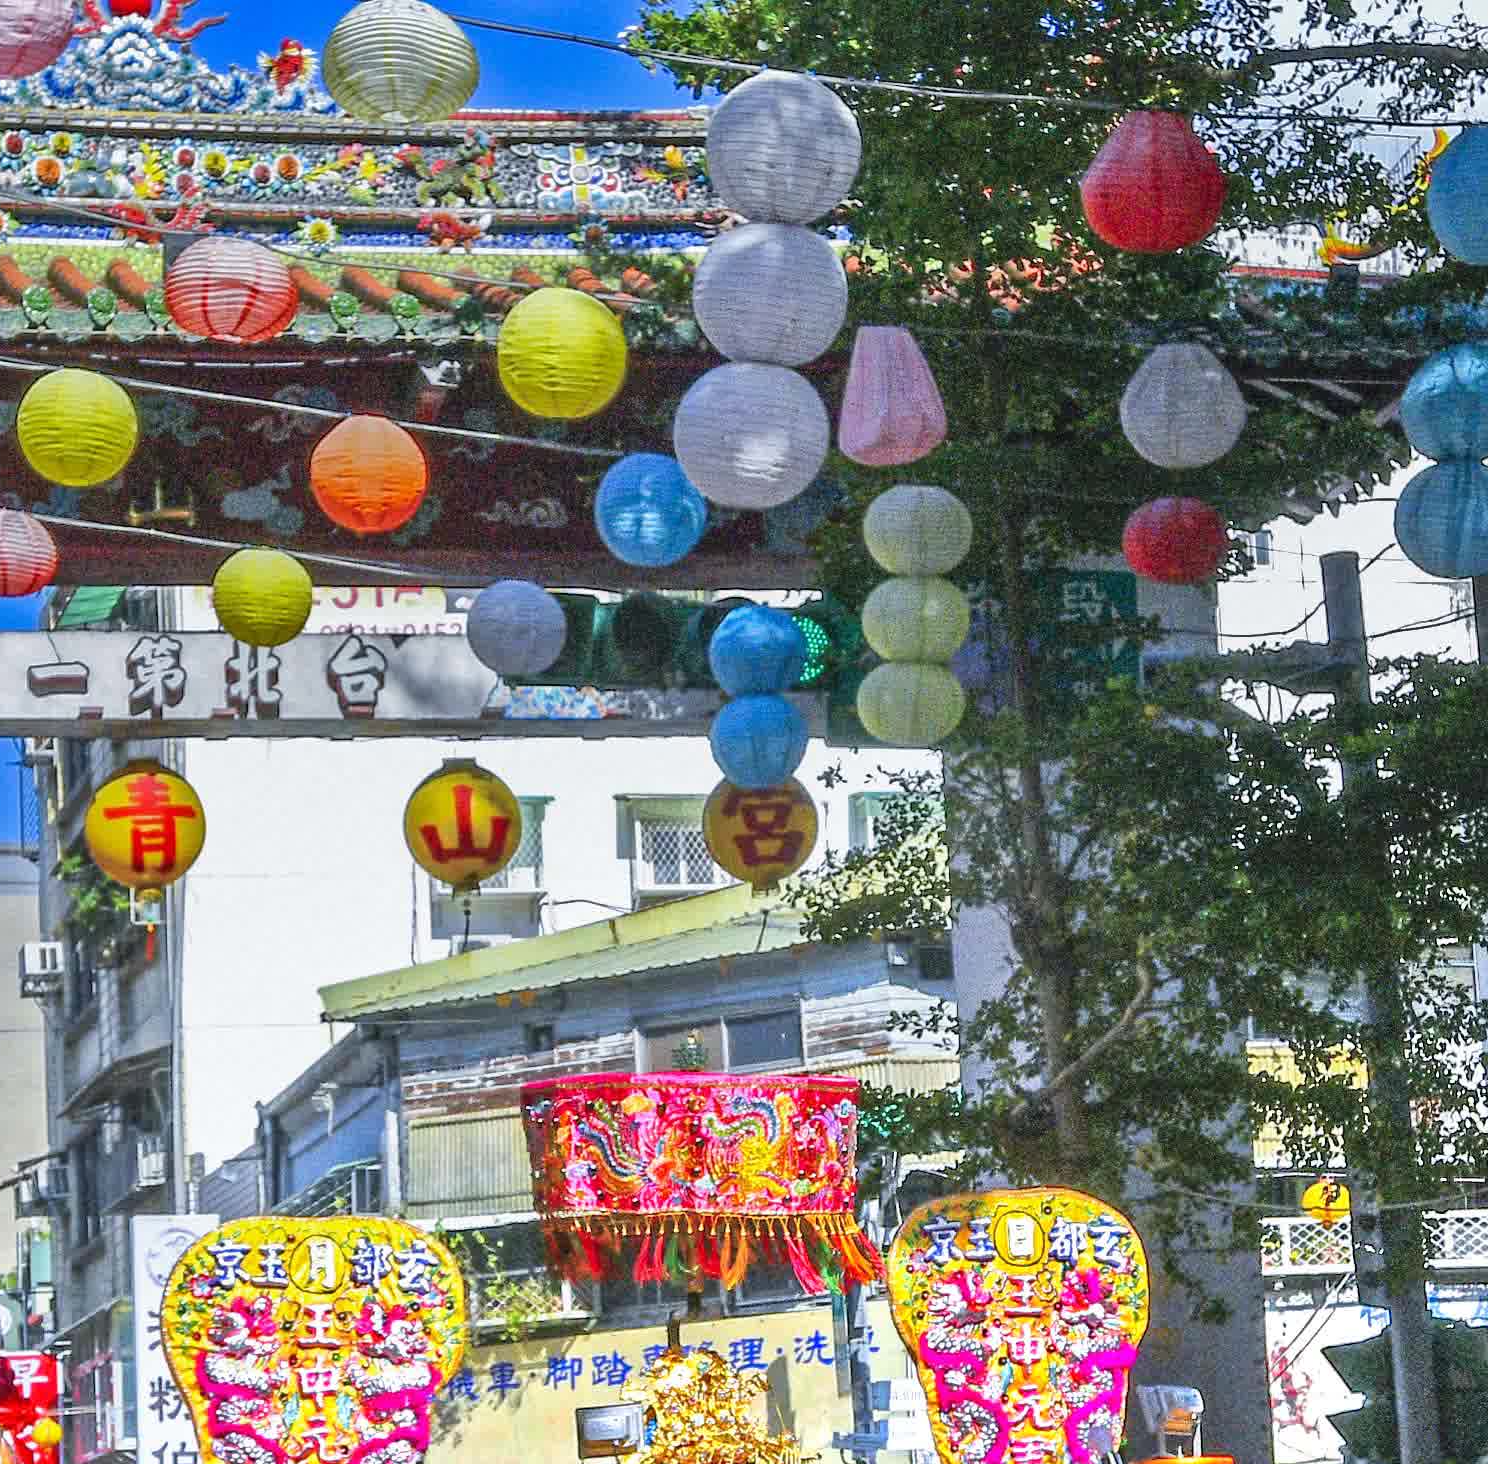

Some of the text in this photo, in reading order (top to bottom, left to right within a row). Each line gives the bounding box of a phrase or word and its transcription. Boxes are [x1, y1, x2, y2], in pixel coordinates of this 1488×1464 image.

[104, 772, 197, 874] 青
[420, 784, 511, 864] 山
[720, 787, 806, 865] 宮
